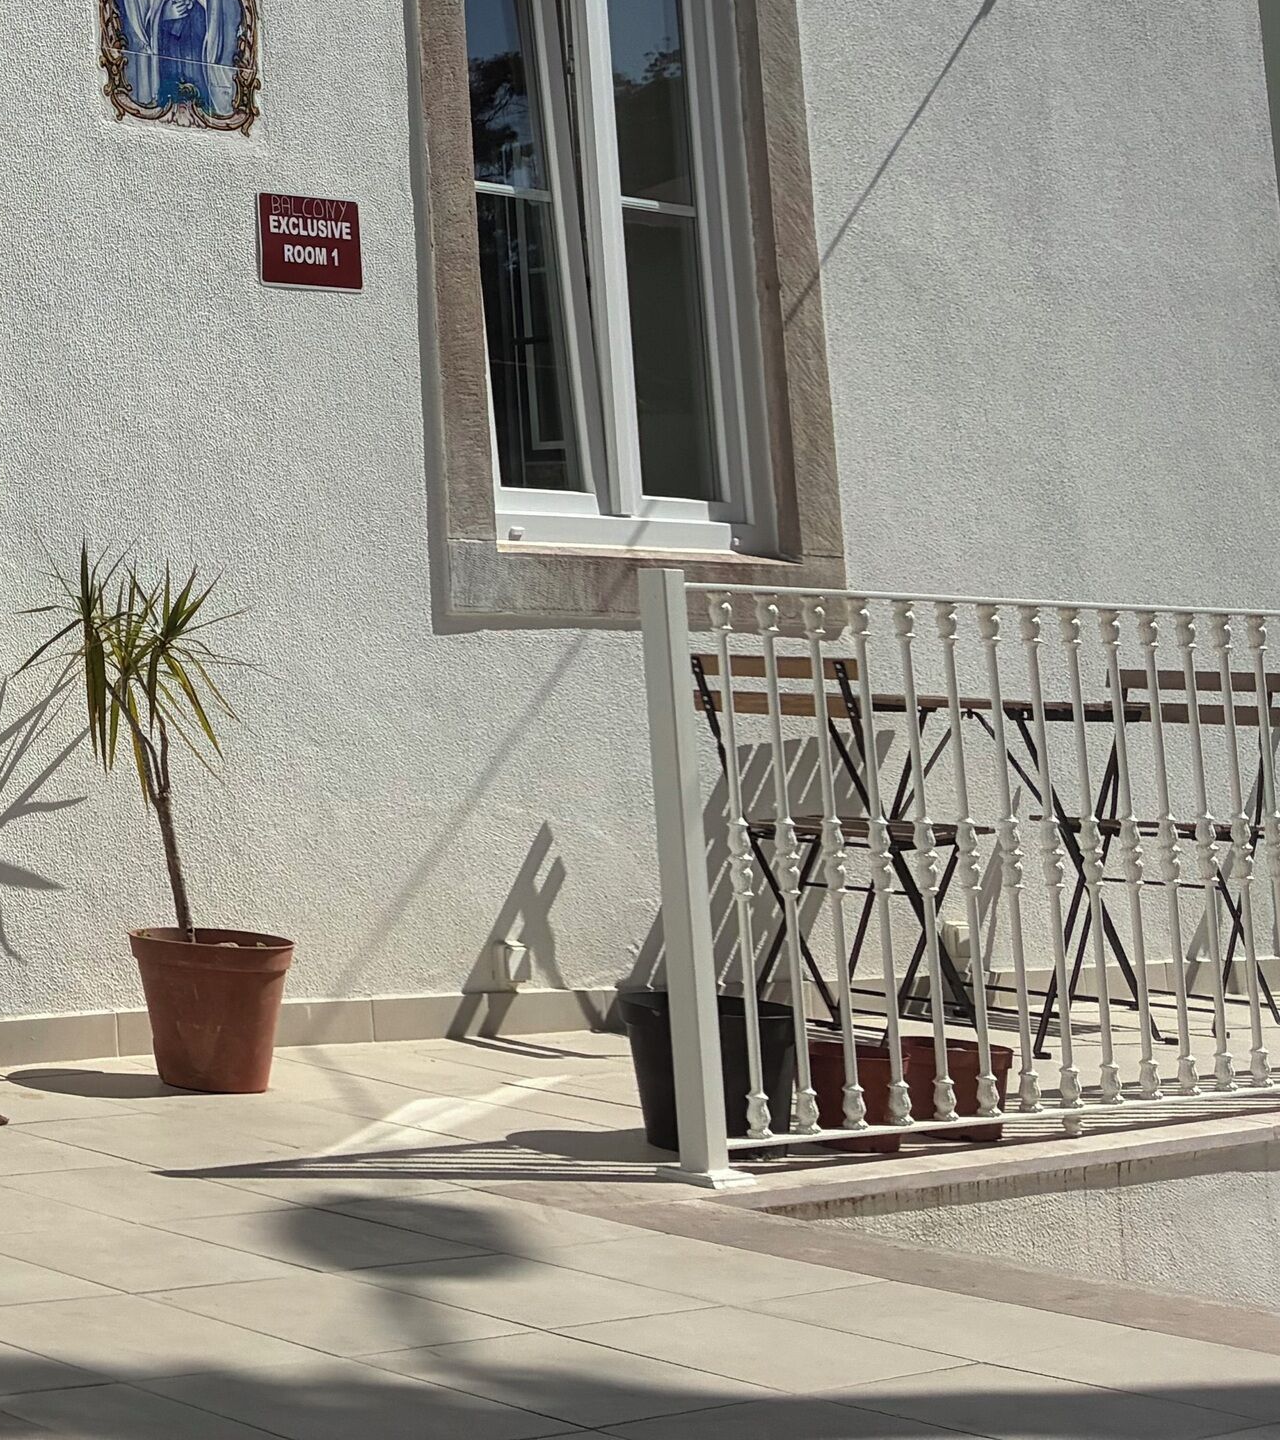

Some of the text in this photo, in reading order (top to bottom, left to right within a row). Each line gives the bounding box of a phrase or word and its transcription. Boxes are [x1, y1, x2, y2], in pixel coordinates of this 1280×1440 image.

[271, 195, 347, 220] BALCONY
[269, 215, 352, 240] EXCLUSIVE
[283, 243, 339, 267] ROOM 1
